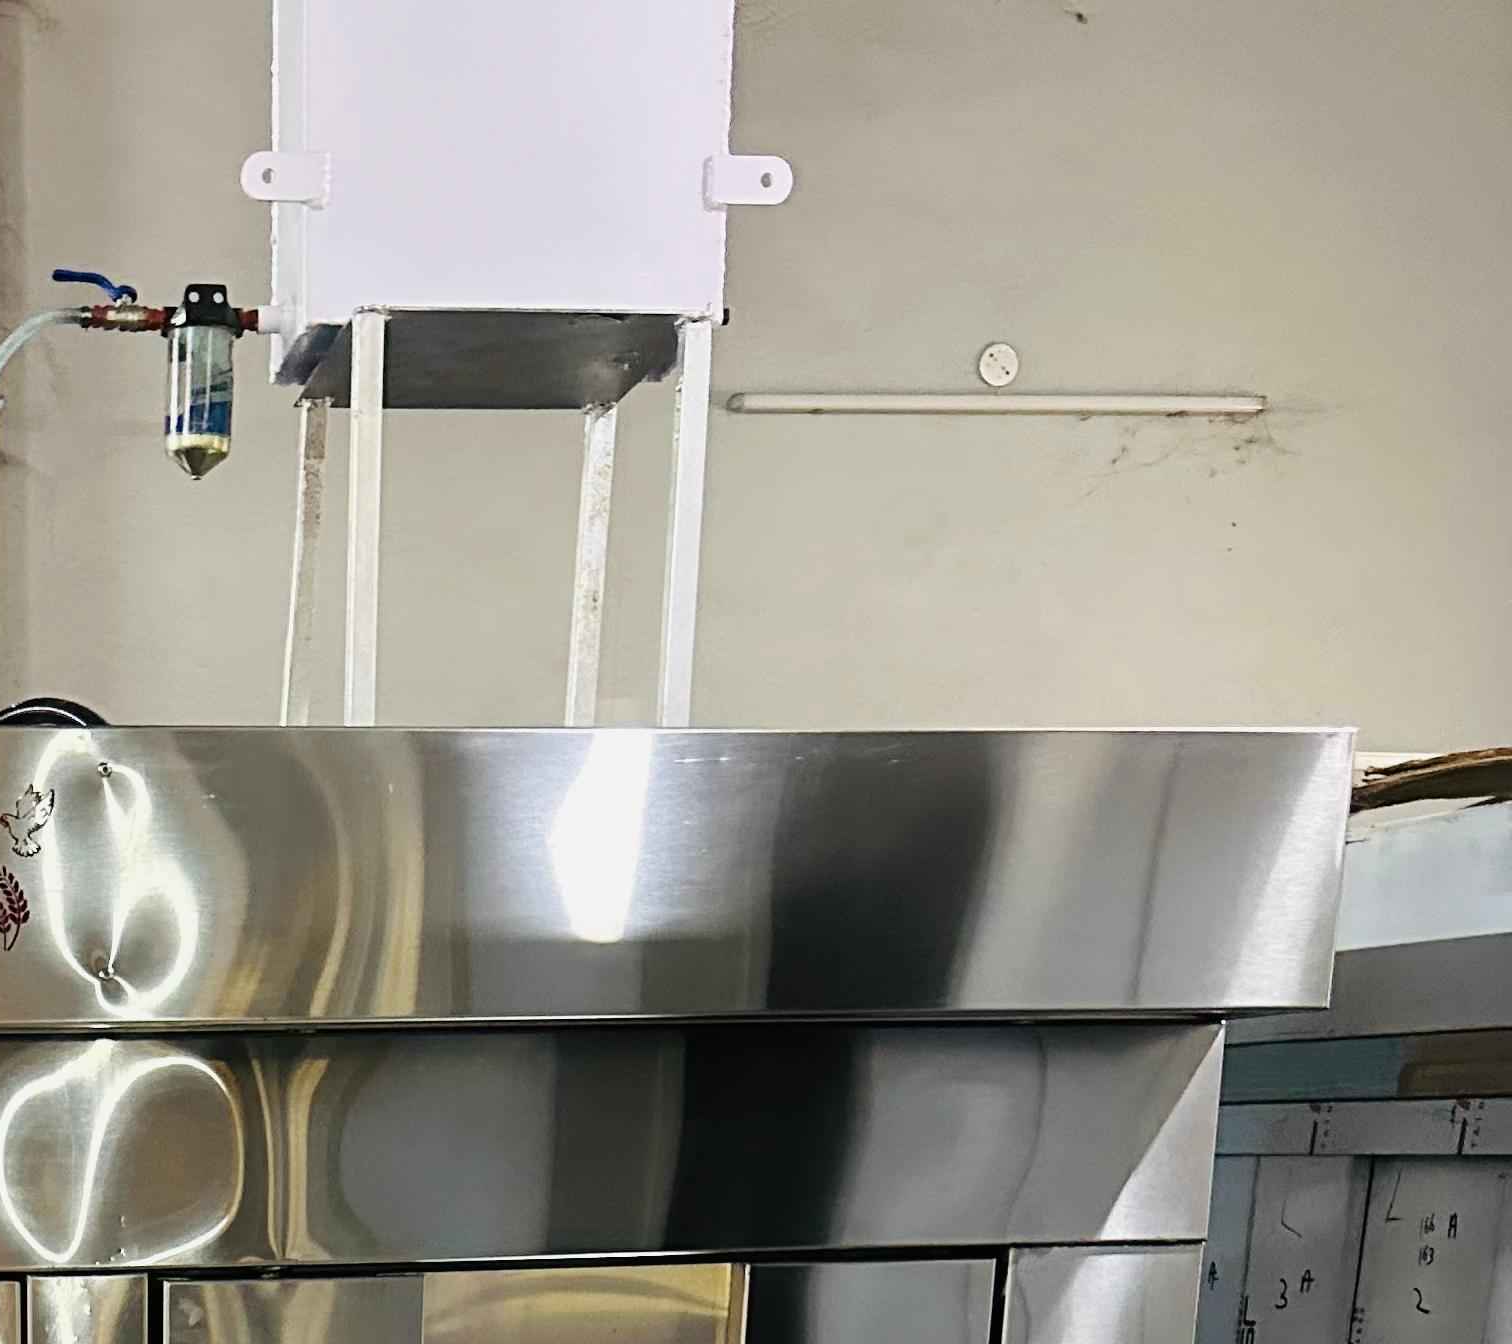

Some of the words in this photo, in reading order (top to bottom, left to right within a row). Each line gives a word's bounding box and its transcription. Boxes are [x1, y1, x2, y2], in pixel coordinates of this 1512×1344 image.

[1447, 1212, 1458, 1239] A
[1275, 1278, 1288, 1310] 3
[1413, 1287, 1430, 1315] 2
